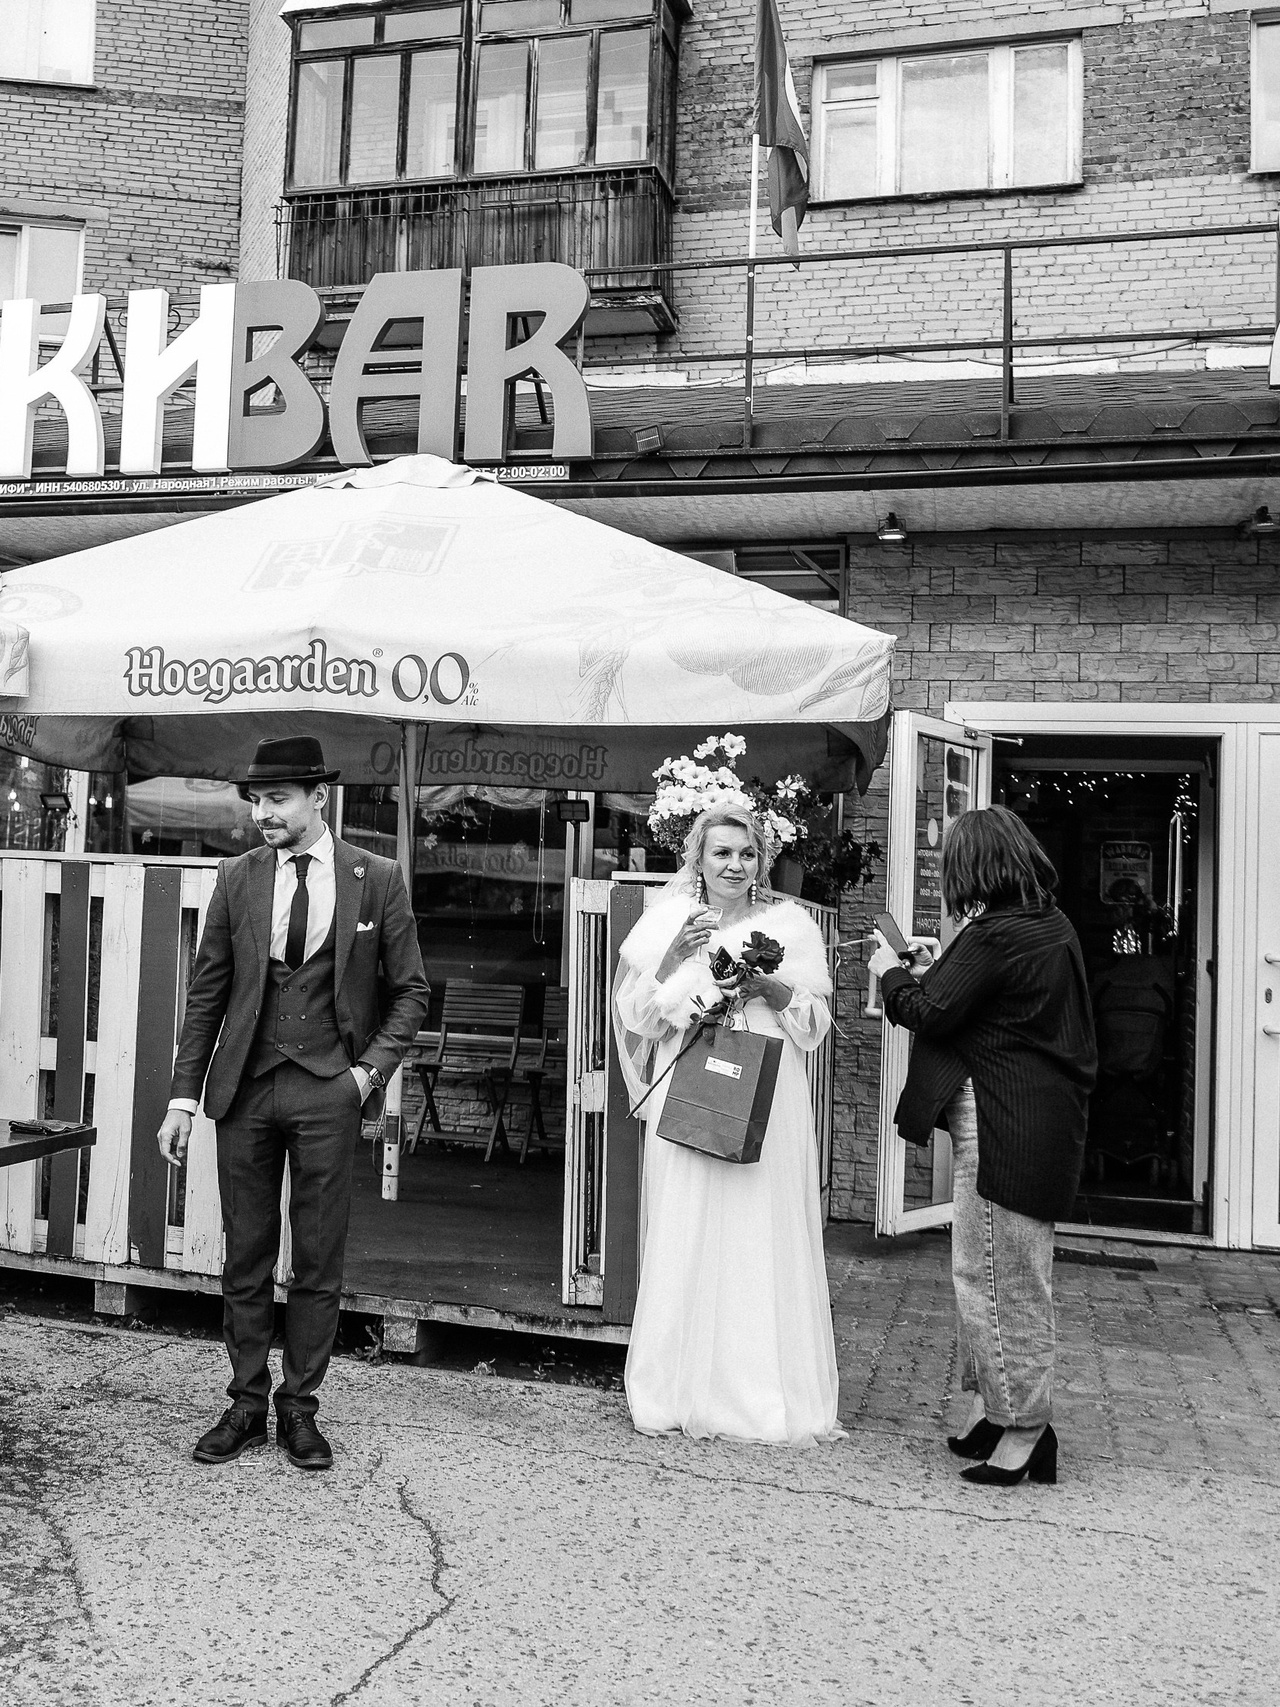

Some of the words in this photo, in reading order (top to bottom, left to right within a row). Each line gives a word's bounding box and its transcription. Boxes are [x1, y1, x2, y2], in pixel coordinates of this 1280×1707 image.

[492, 465, 565, 478] 12:00-02:00
[35, 482, 60, 493] ИНН
[62, 480, 129, 493] 5406805301,
[132, 481, 149, 492] ул.
[220, 476, 260, 487] Режим
[123, 638, 379, 704] Hoegaarden
